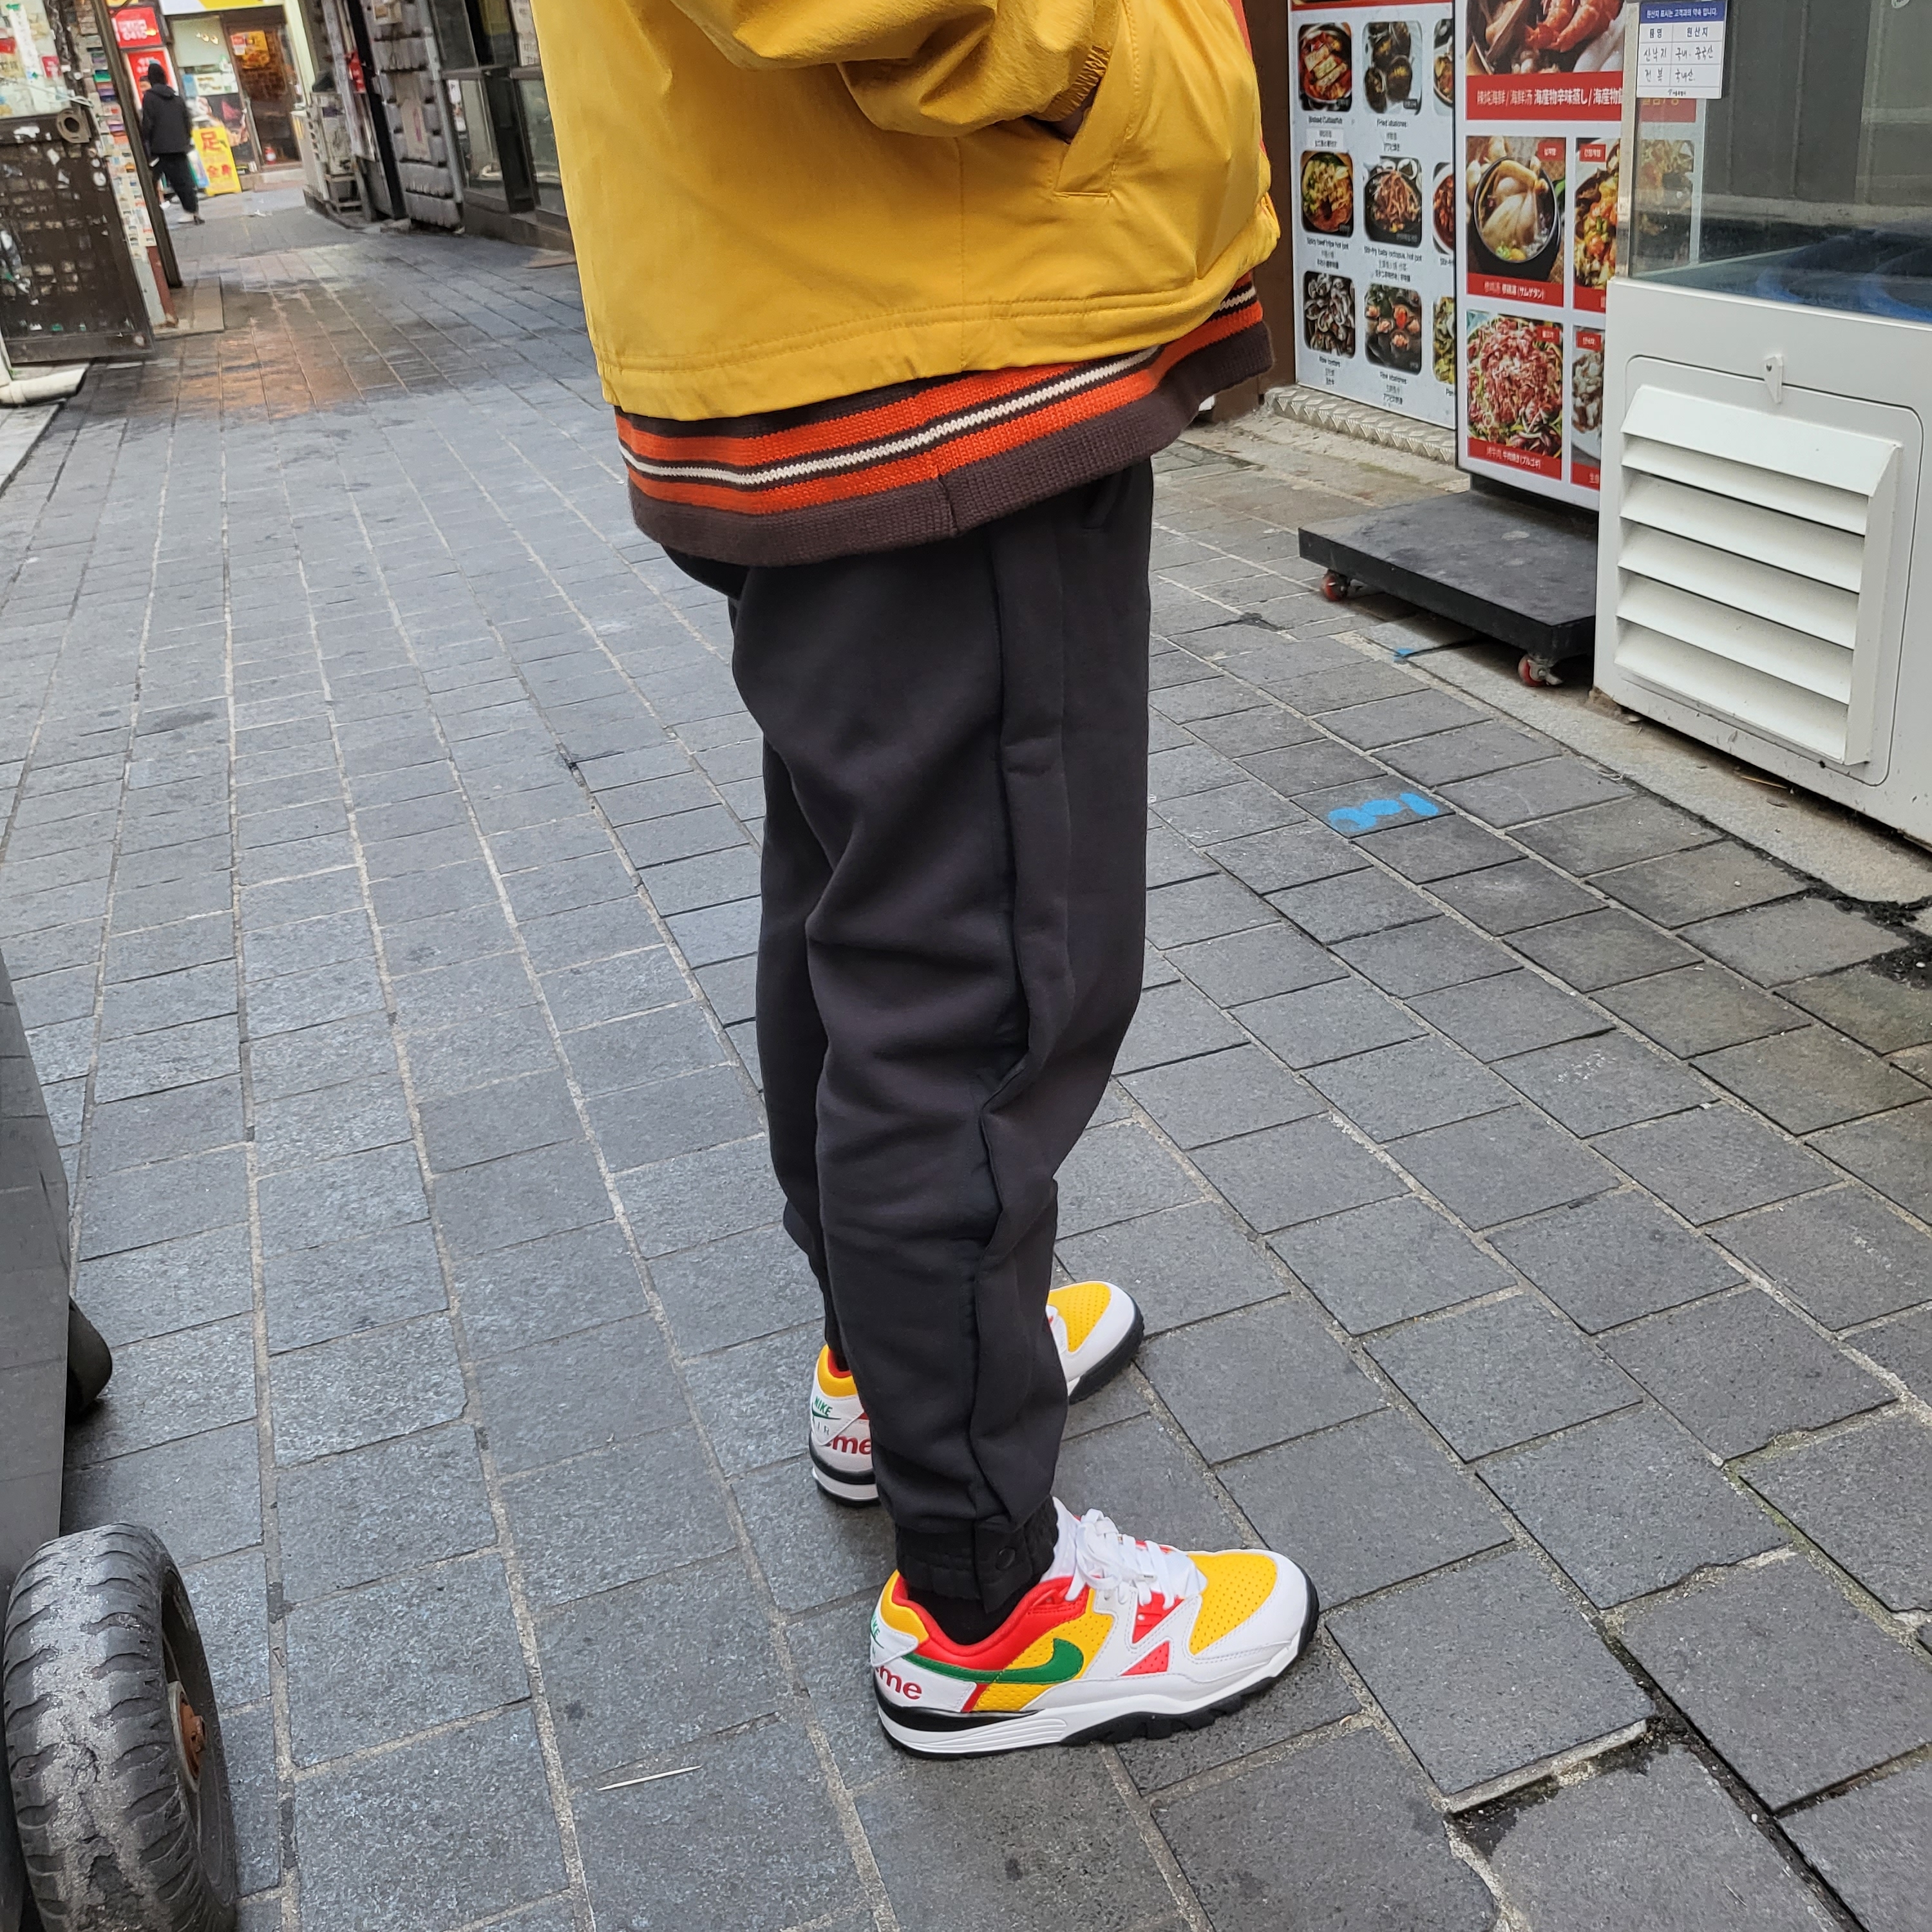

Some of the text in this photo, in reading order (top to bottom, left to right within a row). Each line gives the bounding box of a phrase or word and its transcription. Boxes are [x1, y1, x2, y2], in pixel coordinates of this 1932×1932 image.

[1647, 9, 1660, 19] 원산지
[1660, 9, 1673, 18] 표시는
[1674, 8, 1692, 17] 고객과의
[1692, 8, 1701, 17] 약속
[814, 1396, 833, 1417] NIKE
[824, 1434, 872, 1455] me
[875, 1665, 922, 1700] me
